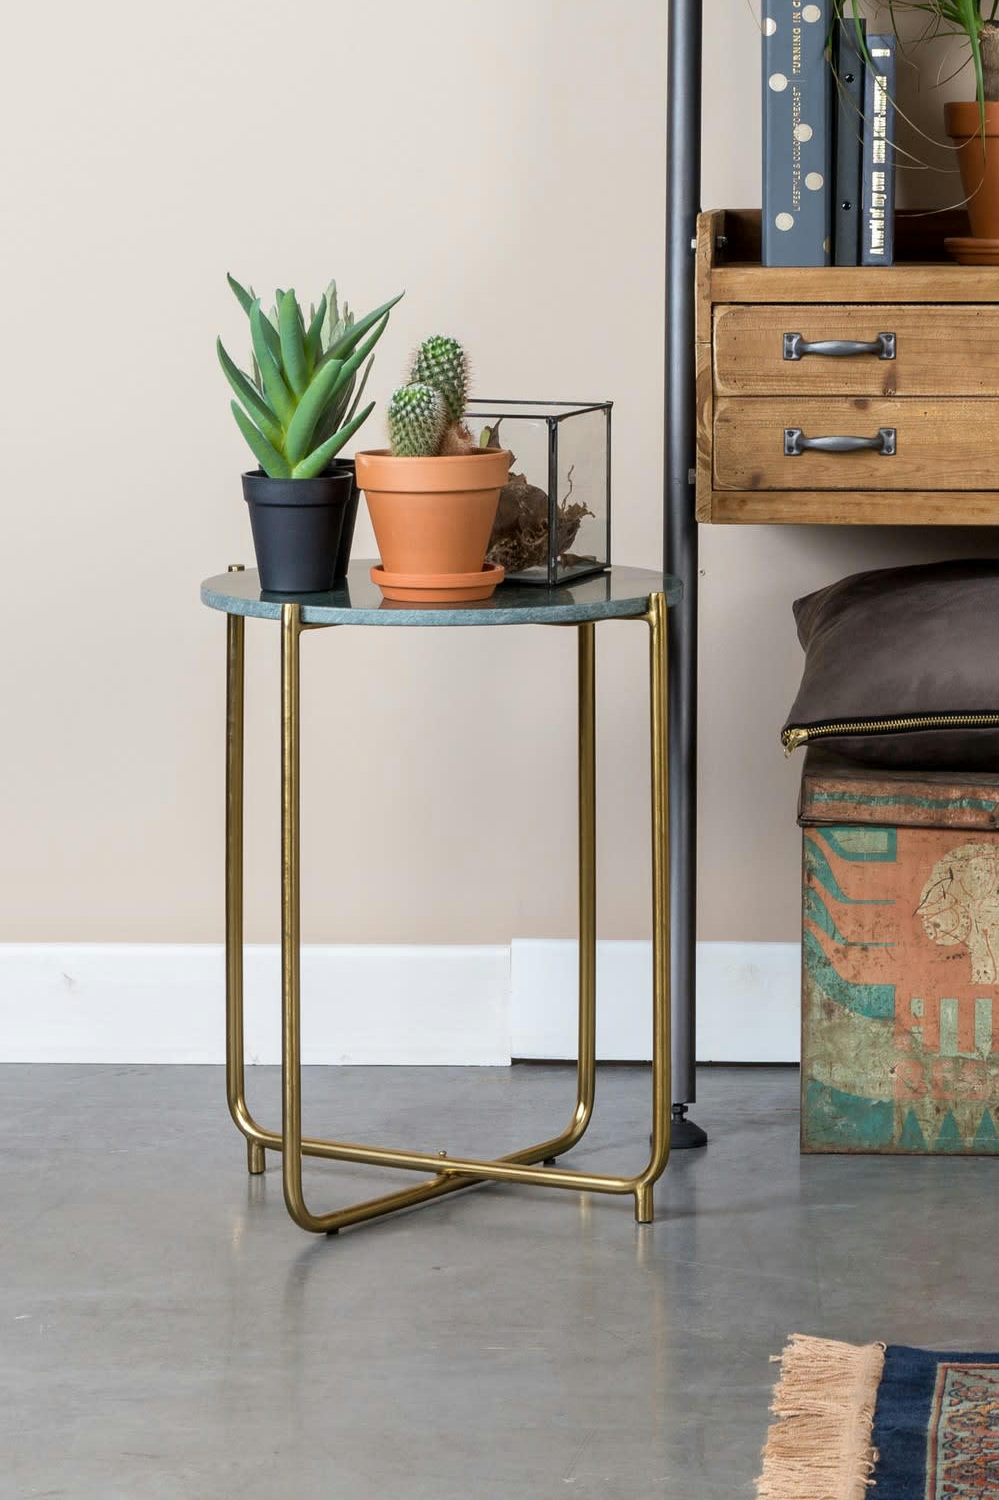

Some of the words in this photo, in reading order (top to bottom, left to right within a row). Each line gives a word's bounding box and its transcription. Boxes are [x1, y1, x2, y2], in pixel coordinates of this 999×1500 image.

[792, 11, 802, 23] IN
[792, 27, 802, 75] TURNING
[792, 86, 801, 127] FORECAST
[792, 171, 801, 212] LIFESTYLE
[871, 171, 885, 191] own
[871, 193, 887, 207] my
[868, 208, 885, 219] of
[868, 219, 885, 247] world
